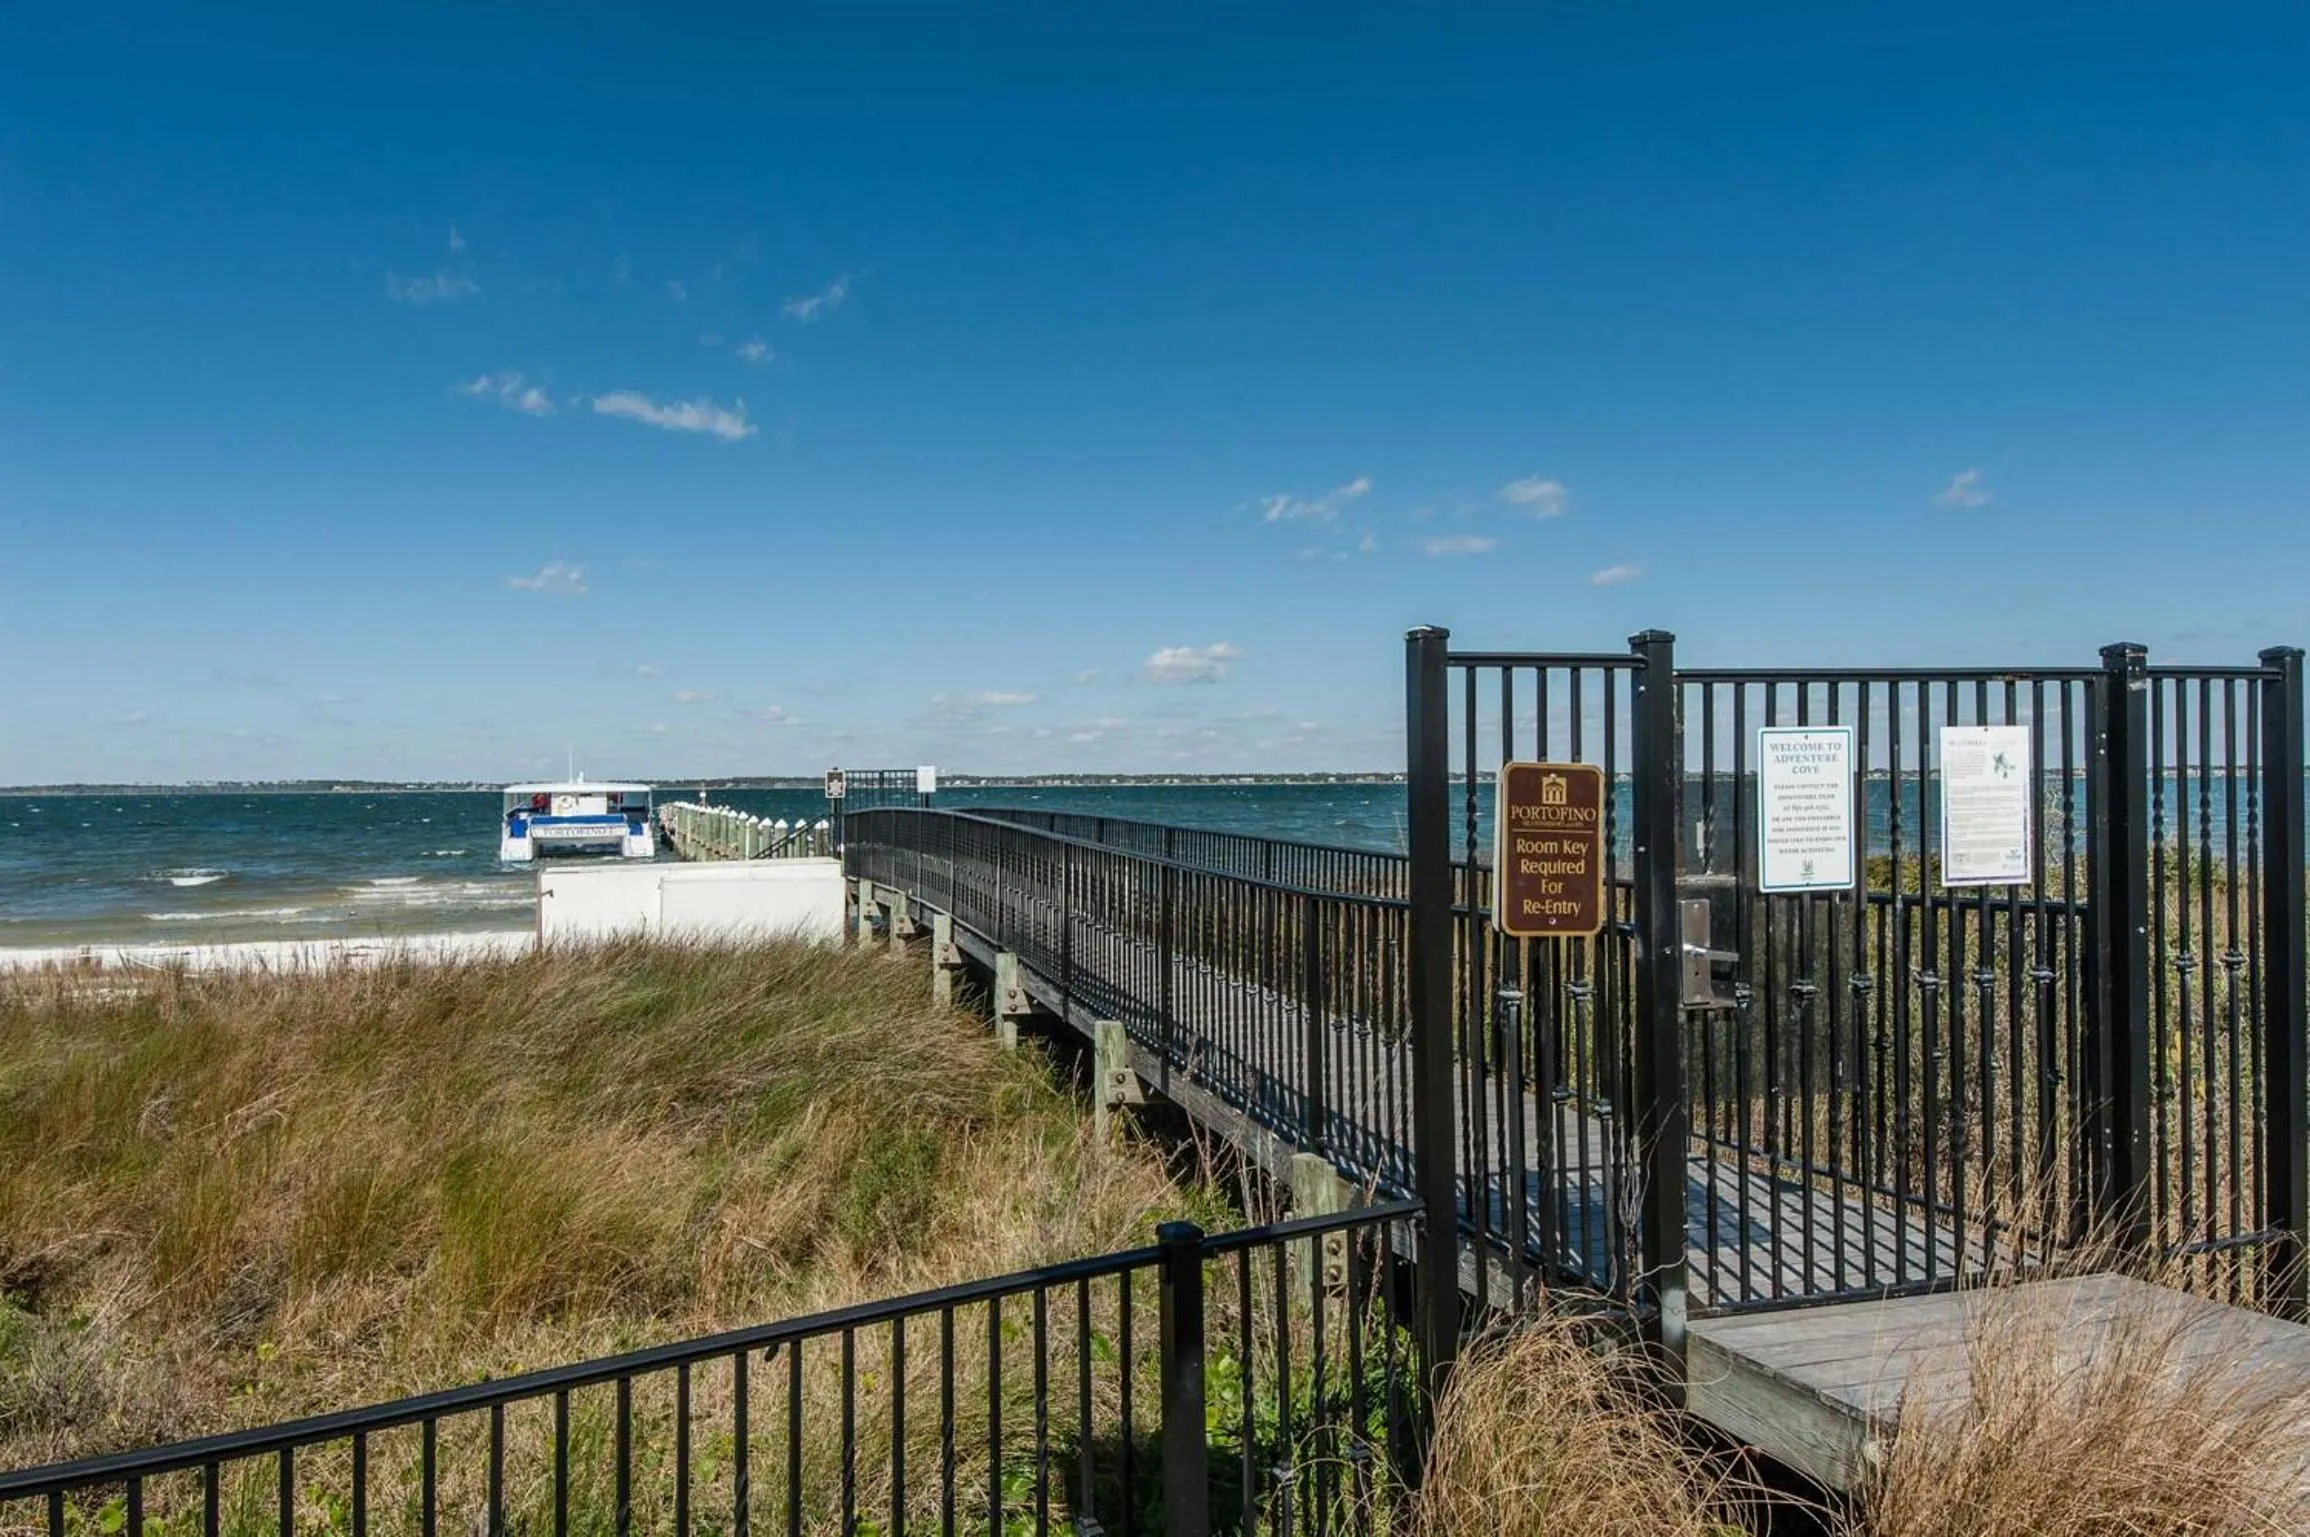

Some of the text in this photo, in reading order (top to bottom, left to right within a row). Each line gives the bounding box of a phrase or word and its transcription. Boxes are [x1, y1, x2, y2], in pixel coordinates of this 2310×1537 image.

[1770, 742, 1842, 752] WELCOME TO
[1773, 753, 1839, 764] ADVENTURE
[1792, 765, 1820, 775] COVE
[1511, 805, 1597, 822] PORTOFINO
[1516, 838, 1589, 857] Room Key
[1520, 858, 1586, 877] Required
[1541, 878, 1565, 894] For
[1522, 898, 1582, 918] Re-Entry
